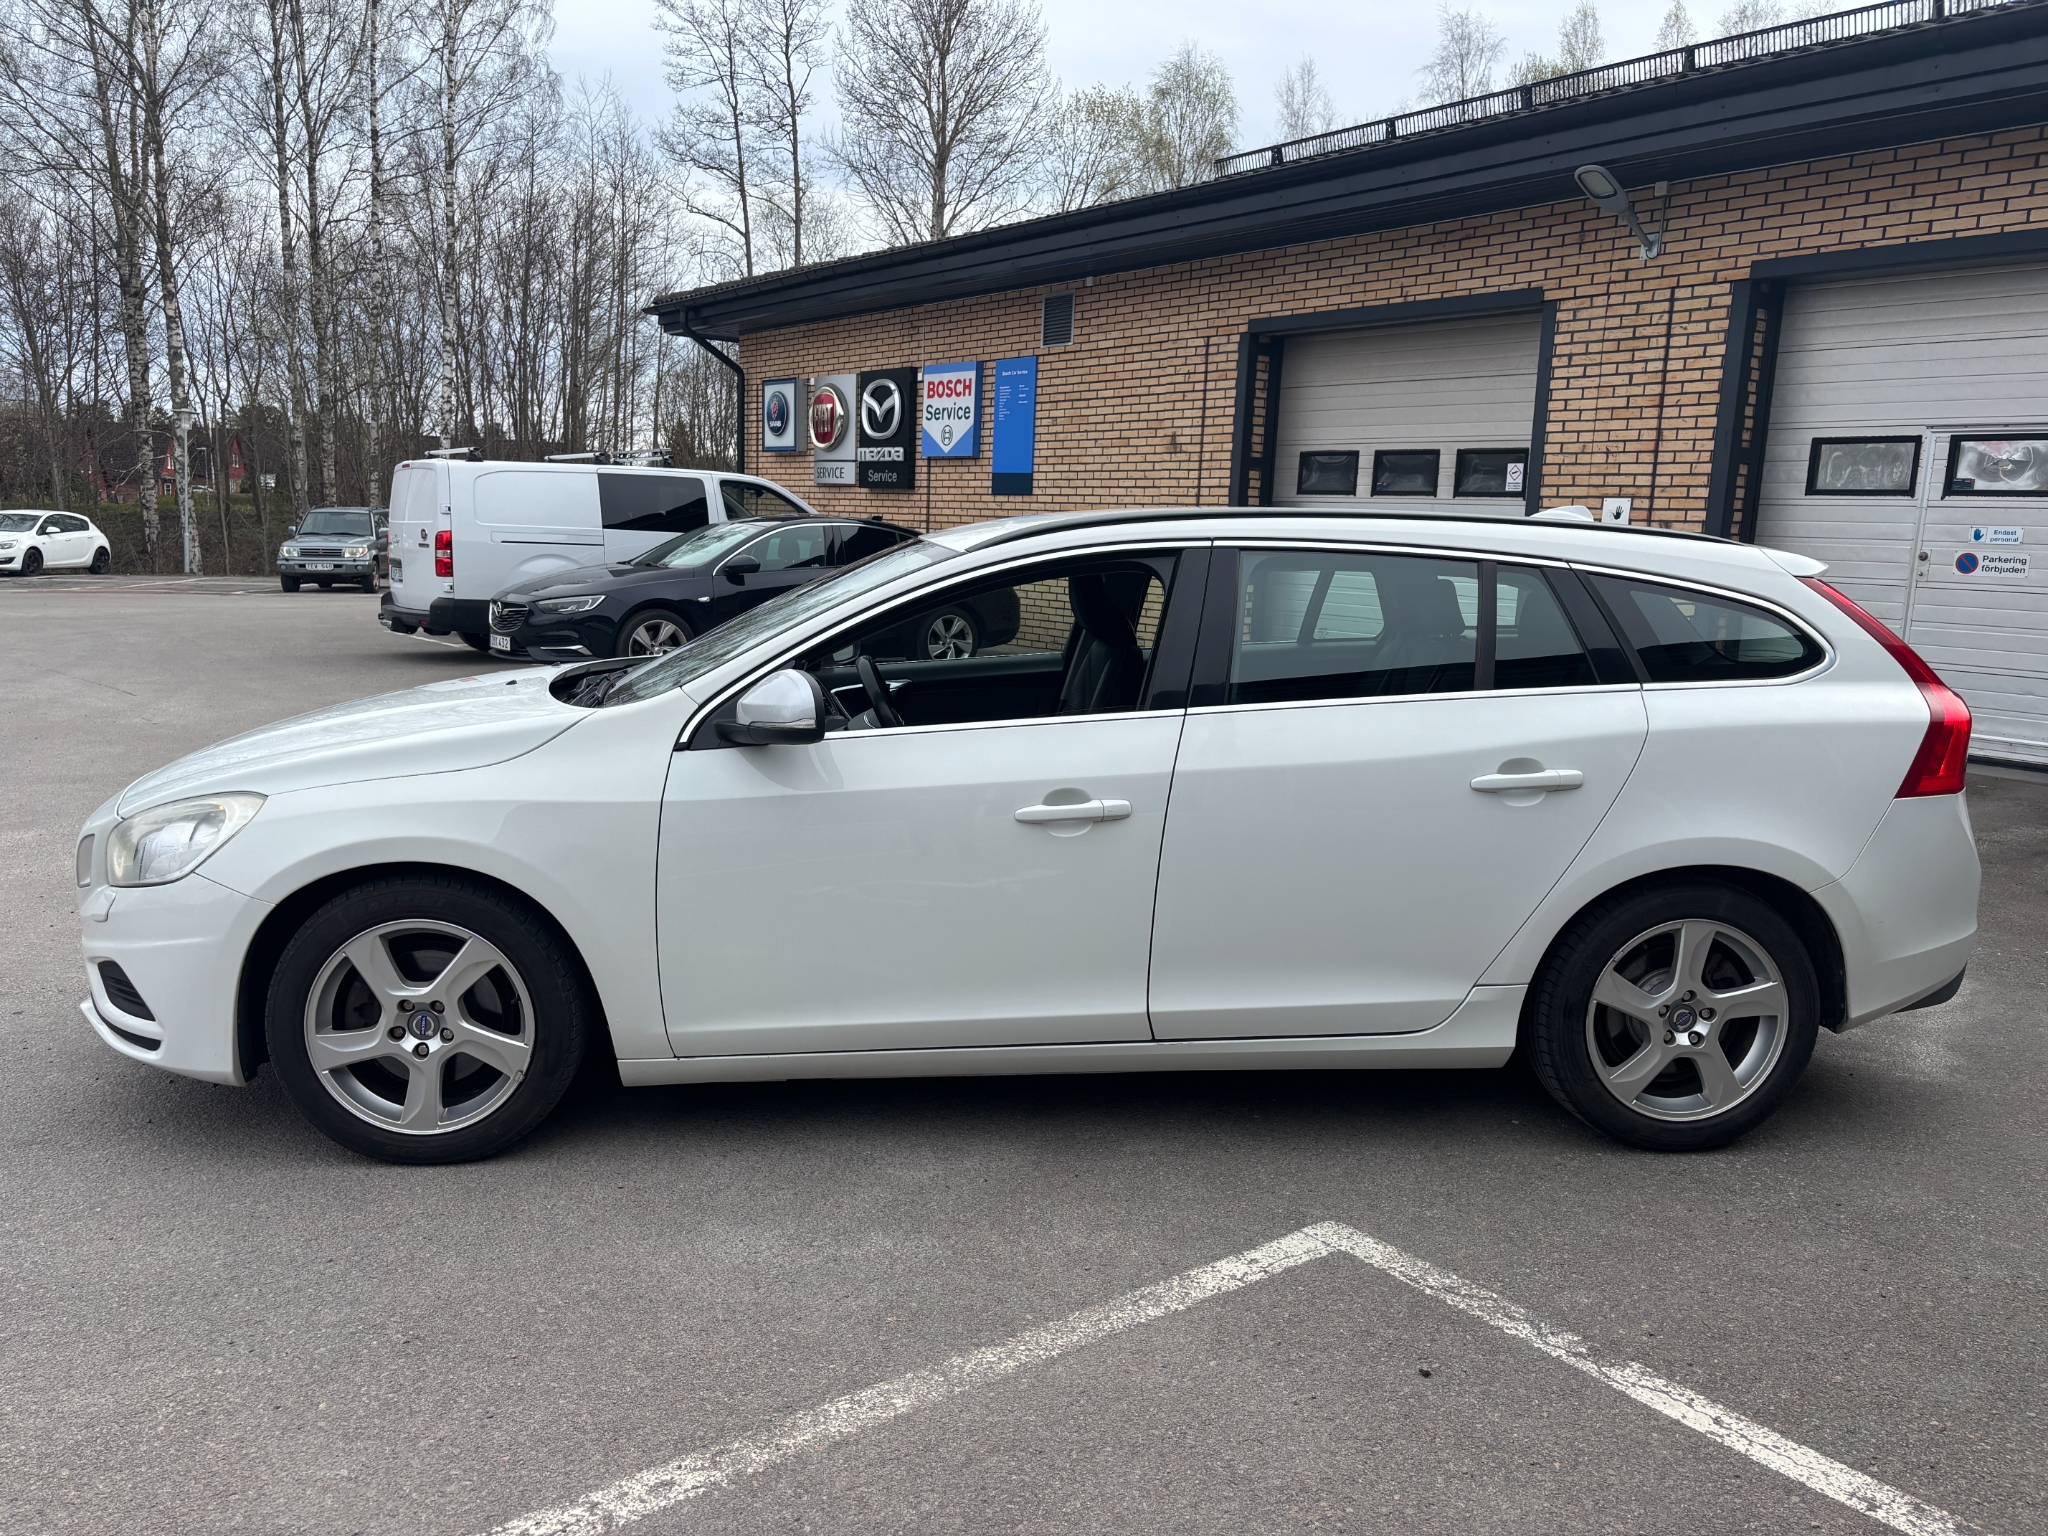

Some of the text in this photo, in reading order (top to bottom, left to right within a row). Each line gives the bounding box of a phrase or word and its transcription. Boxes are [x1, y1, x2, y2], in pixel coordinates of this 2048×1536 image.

[927, 378, 972, 399] BOSCH
[814, 403, 833, 433] FIAT
[925, 402, 971, 421] Service
[816, 467, 845, 479] SERVICE
[868, 469, 898, 482] Service
[1982, 555, 2027, 566] Parkering
[1981, 565, 2026, 574] förbjuden
